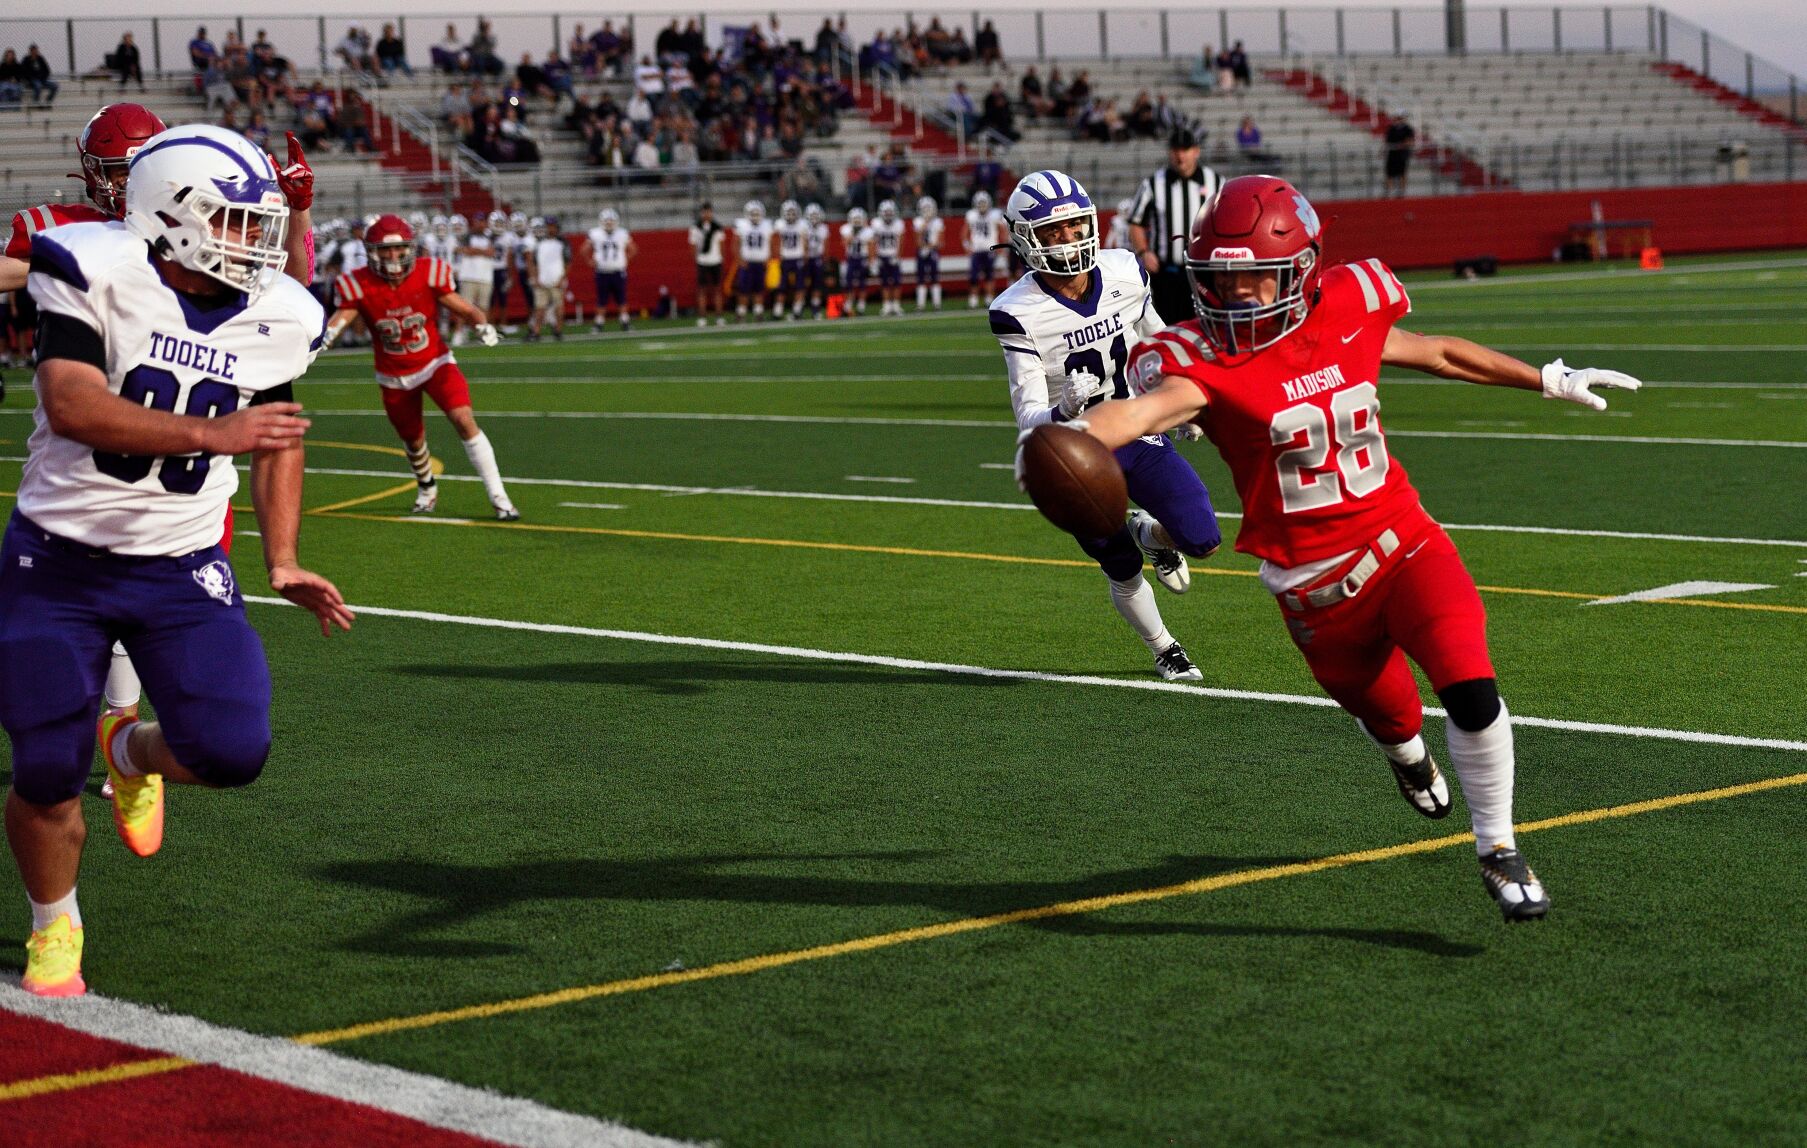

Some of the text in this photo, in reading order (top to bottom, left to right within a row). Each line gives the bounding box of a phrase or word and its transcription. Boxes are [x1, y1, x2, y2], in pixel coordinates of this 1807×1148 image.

[1214, 250, 1247, 259] Riddell
[375, 312, 430, 355] 23
[1063, 312, 1123, 350] TOOELE
[149, 330, 238, 380] TOOELE
[1281, 364, 1346, 402] MADISON
[1269, 380, 1390, 514] 28
